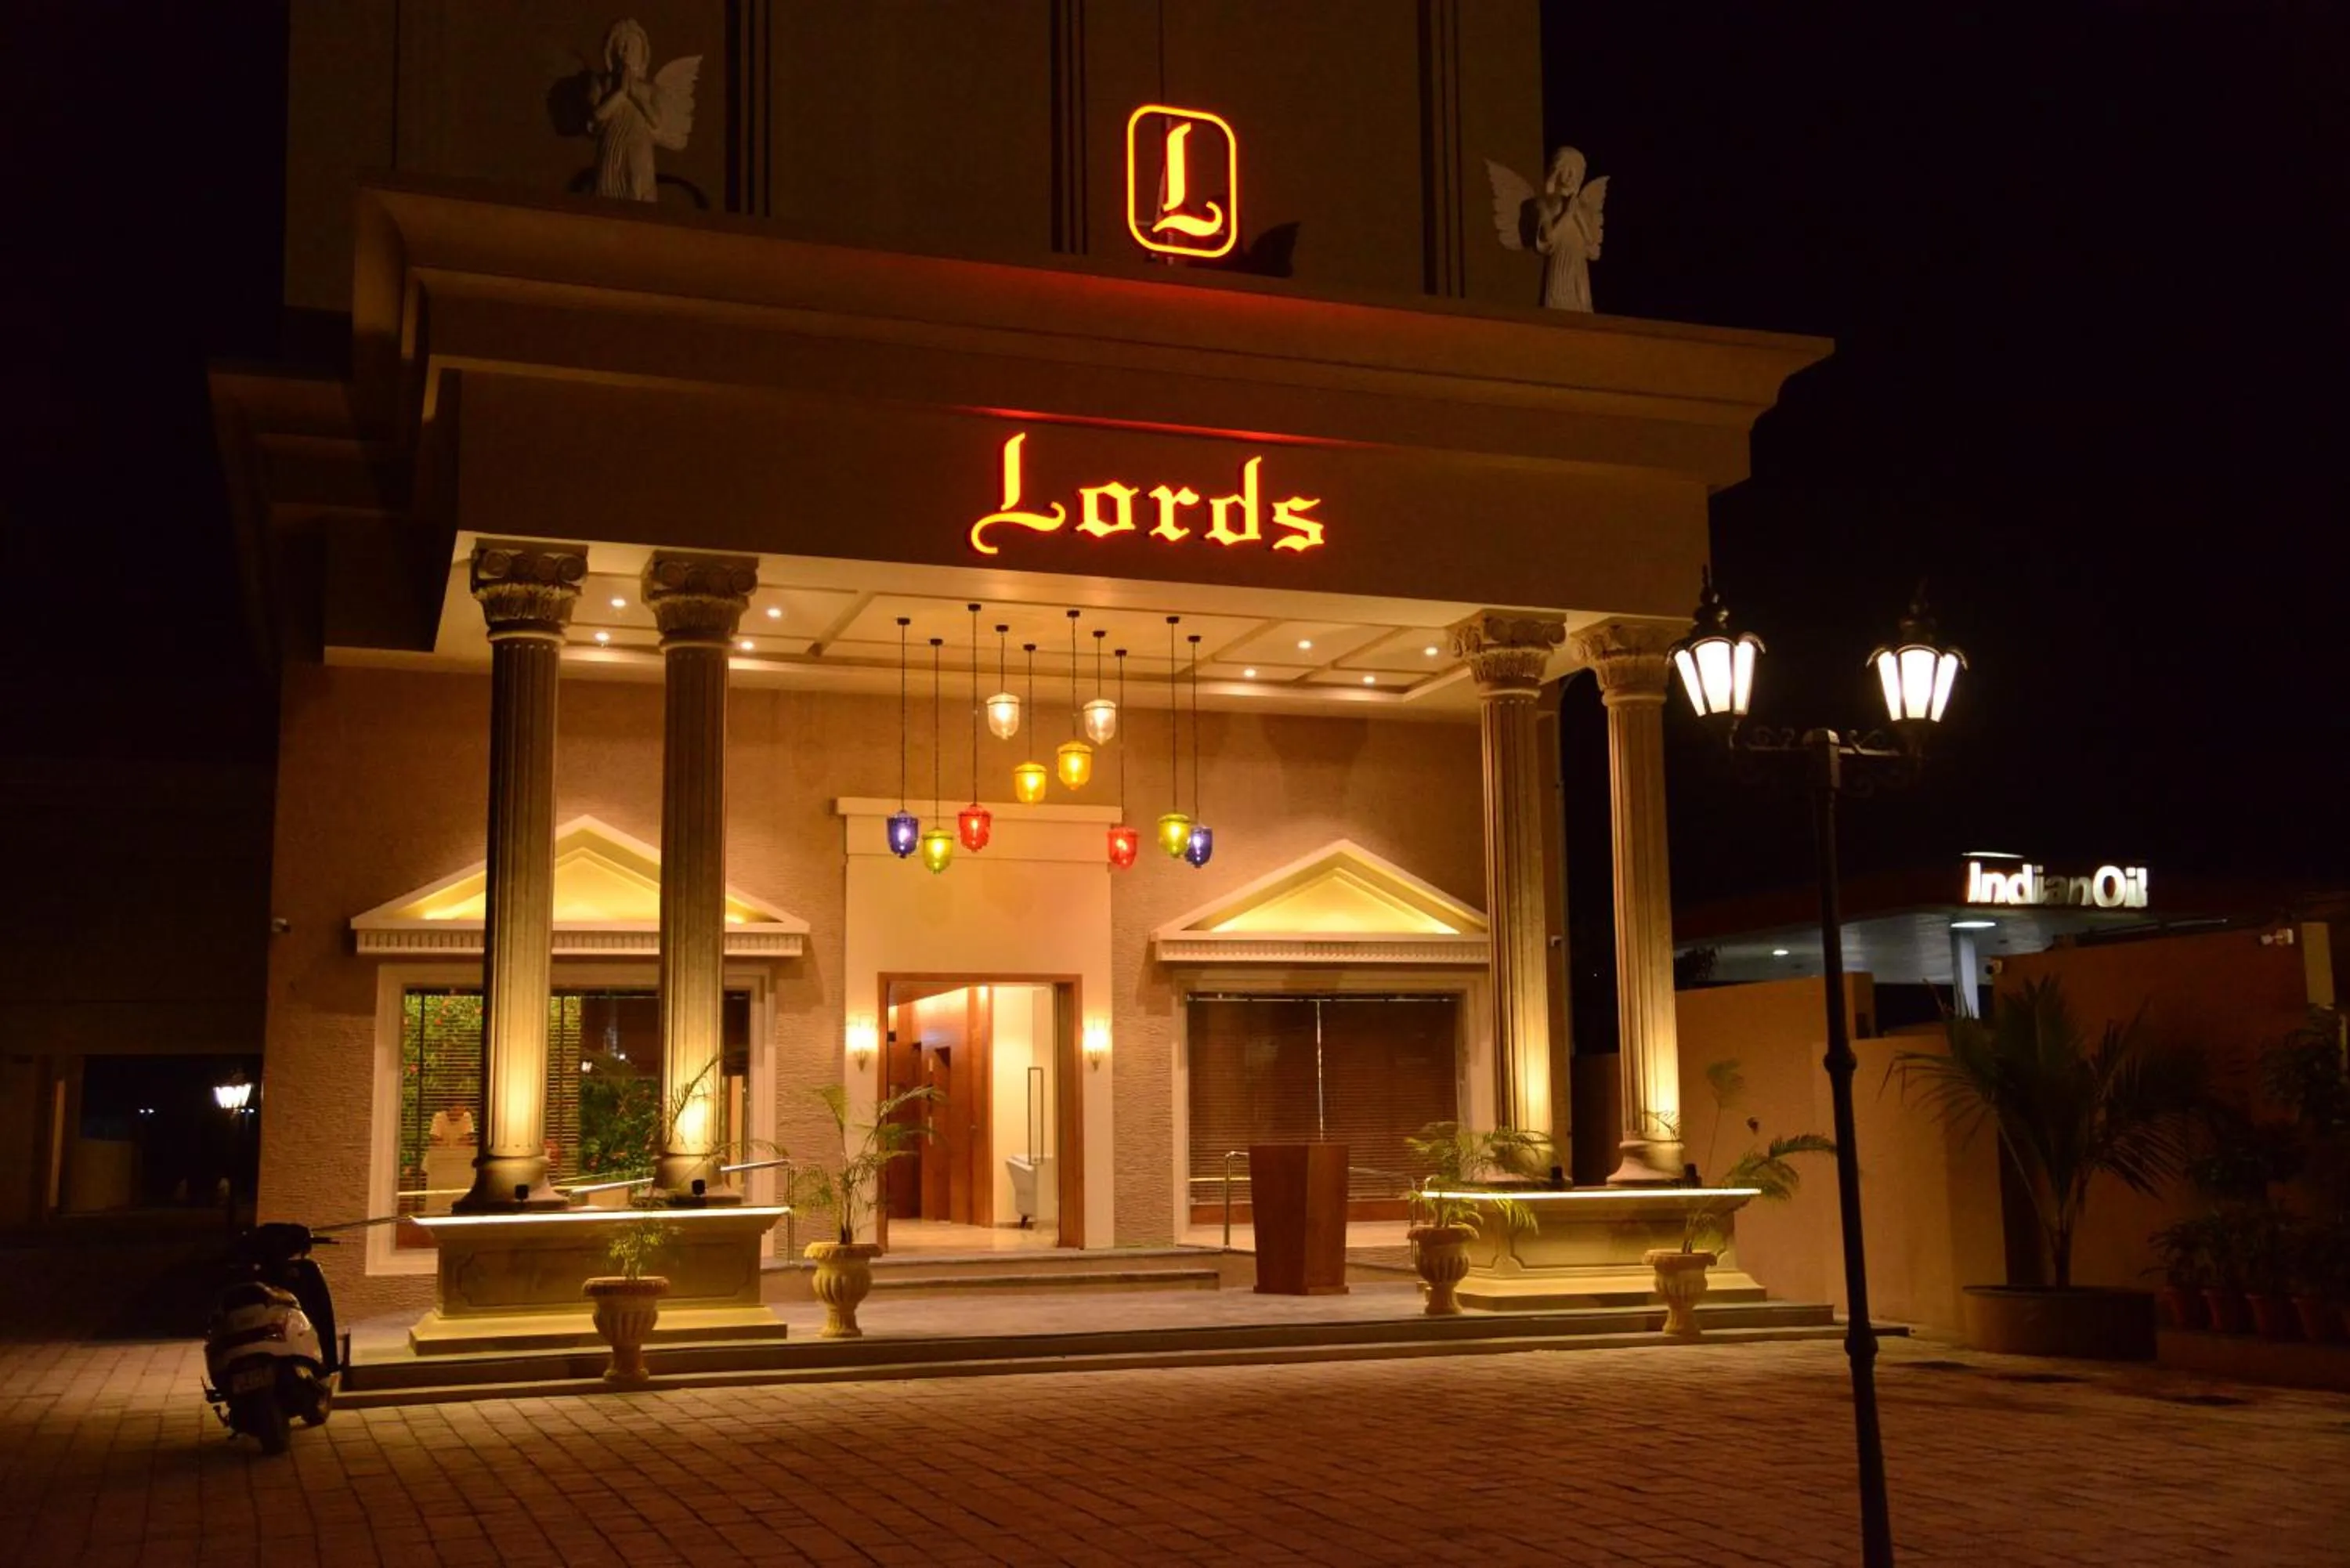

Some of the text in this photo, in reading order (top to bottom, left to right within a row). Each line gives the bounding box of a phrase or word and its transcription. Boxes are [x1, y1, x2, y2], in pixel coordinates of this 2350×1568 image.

[1152, 122, 1223, 237] L
[971, 432, 1325, 555] Lords
[1967, 862, 2147, 908] IndianOil
